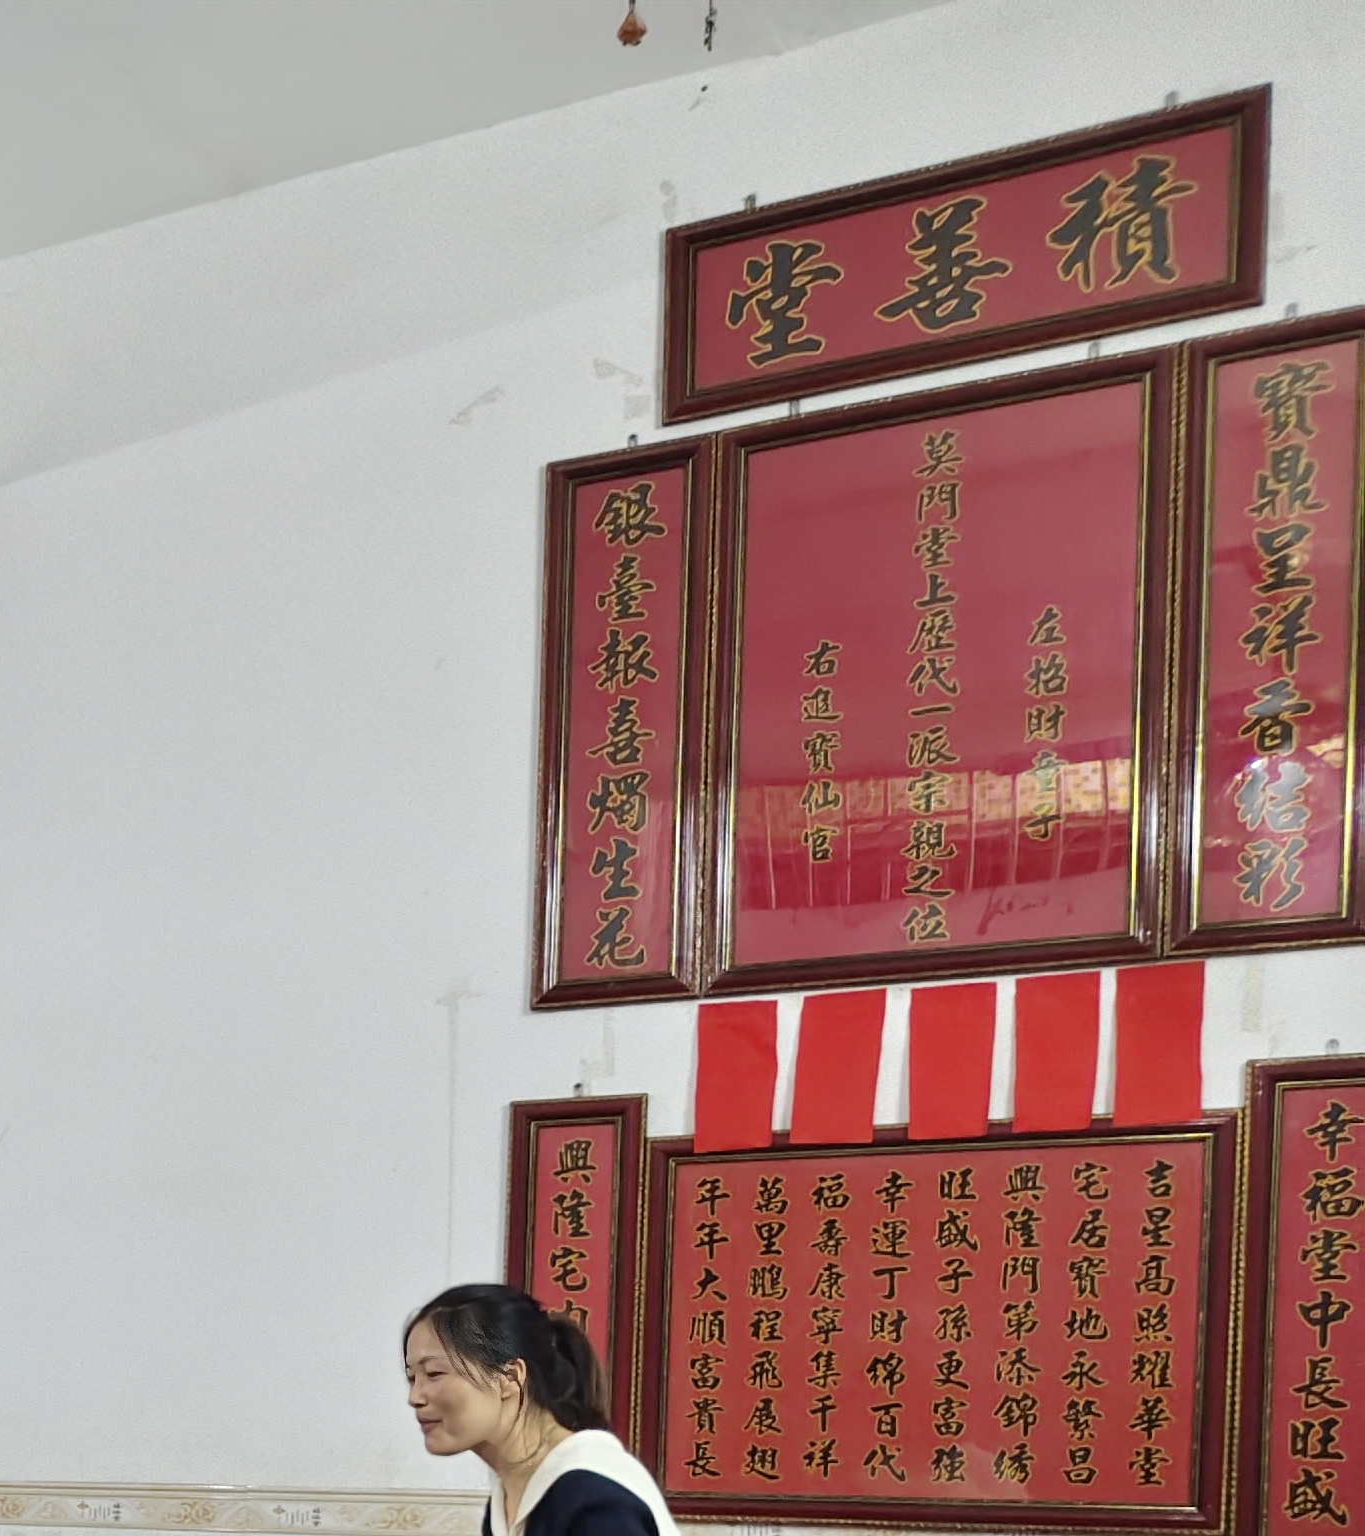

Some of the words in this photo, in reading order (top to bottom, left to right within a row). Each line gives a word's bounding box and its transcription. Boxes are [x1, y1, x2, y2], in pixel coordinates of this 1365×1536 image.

[727, 157, 1198, 368] 積善堂
[1284, 1099, 1365, 1527] 幸福堂中長旺盛
